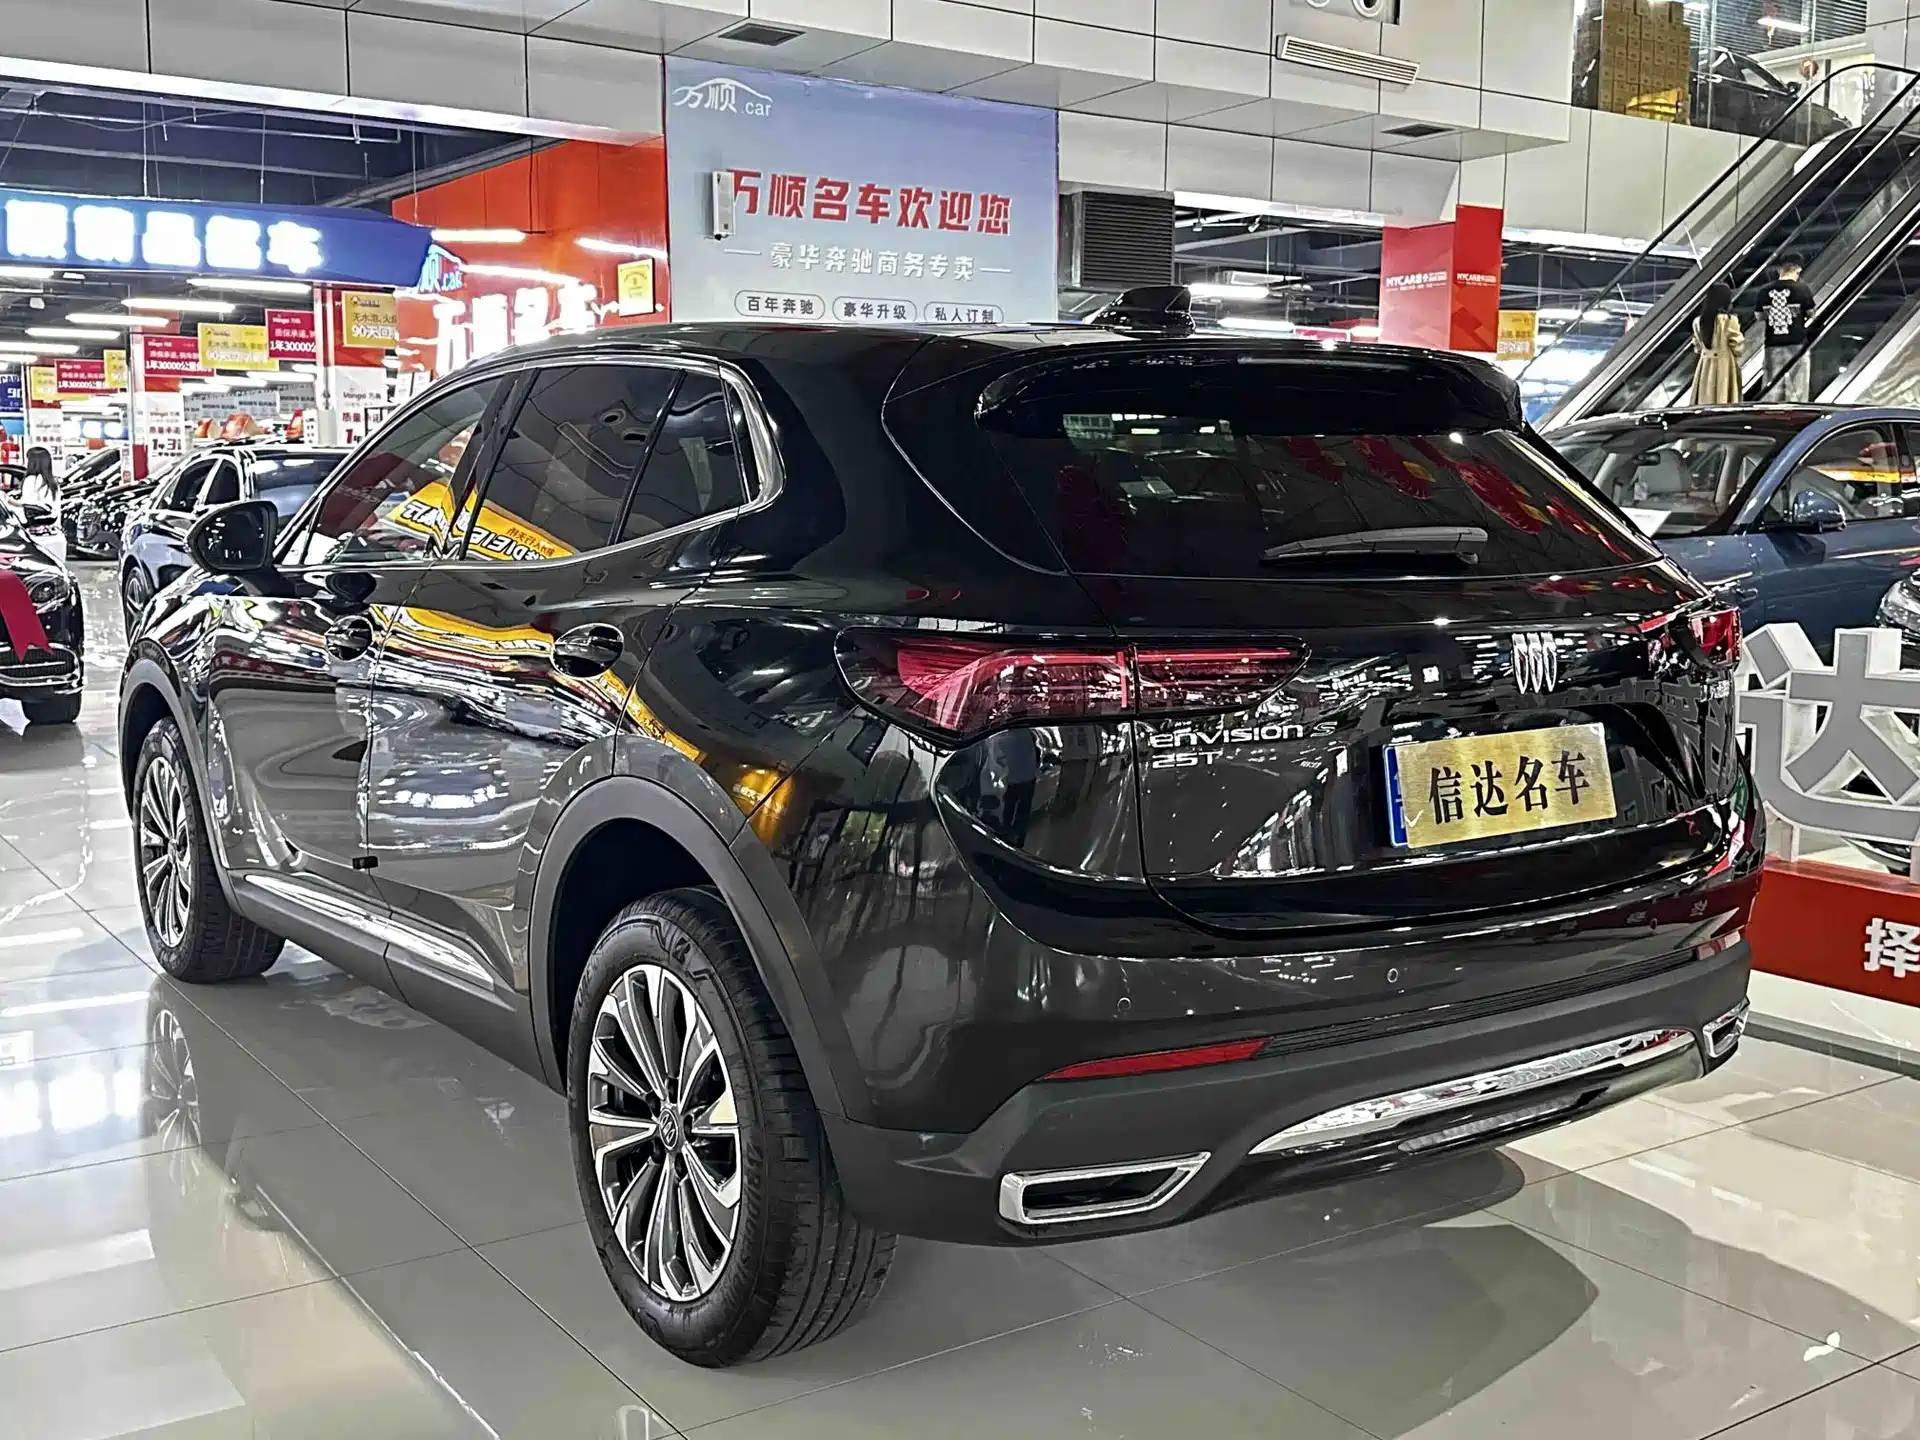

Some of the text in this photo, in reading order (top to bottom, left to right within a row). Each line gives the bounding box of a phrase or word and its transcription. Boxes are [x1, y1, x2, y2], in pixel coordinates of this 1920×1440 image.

[726, 168, 1012, 236] 万顺名车欢迎您
[770, 242, 976, 281] 豪华奔驰商务专卖
[747, 295, 815, 316] 百年奔驰
[843, 302, 907, 321] 豪华升级
[934, 306, 994, 323] 私人订制
[1737, 630, 1920, 842] 达
[1429, 750, 1590, 826] 信达名车
